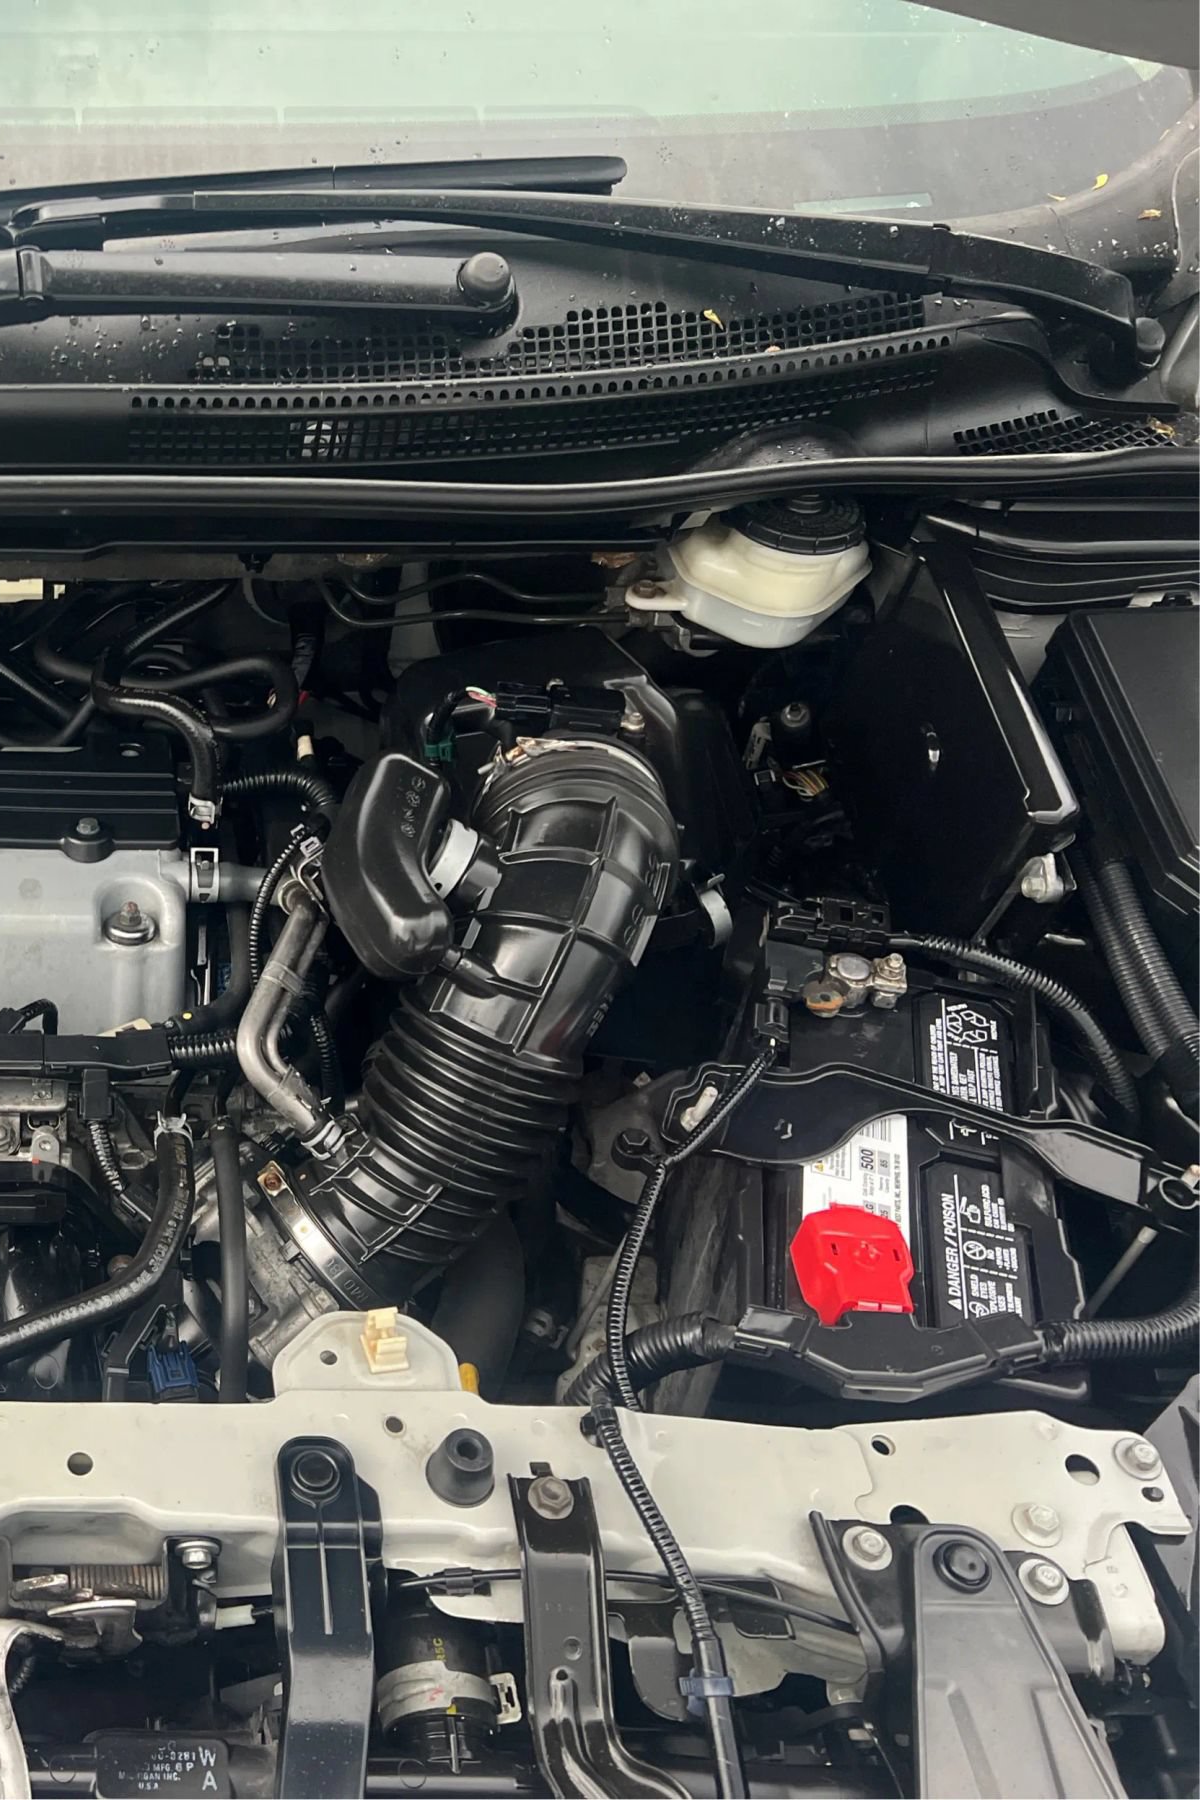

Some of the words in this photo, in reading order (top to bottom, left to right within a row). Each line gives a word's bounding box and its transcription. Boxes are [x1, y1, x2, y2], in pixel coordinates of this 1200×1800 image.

[861, 1149, 873, 1170] 500
[981, 1184, 990, 1198] ACID
[982, 1199, 992, 1227] SULFURIC
[987, 1250, 994, 1260] NO
[970, 1274, 979, 1297] SHIELD
[980, 1282, 988, 1299] EYES
[198, 1746, 216, 1766] W
[202, 1770, 217, 1791] A
